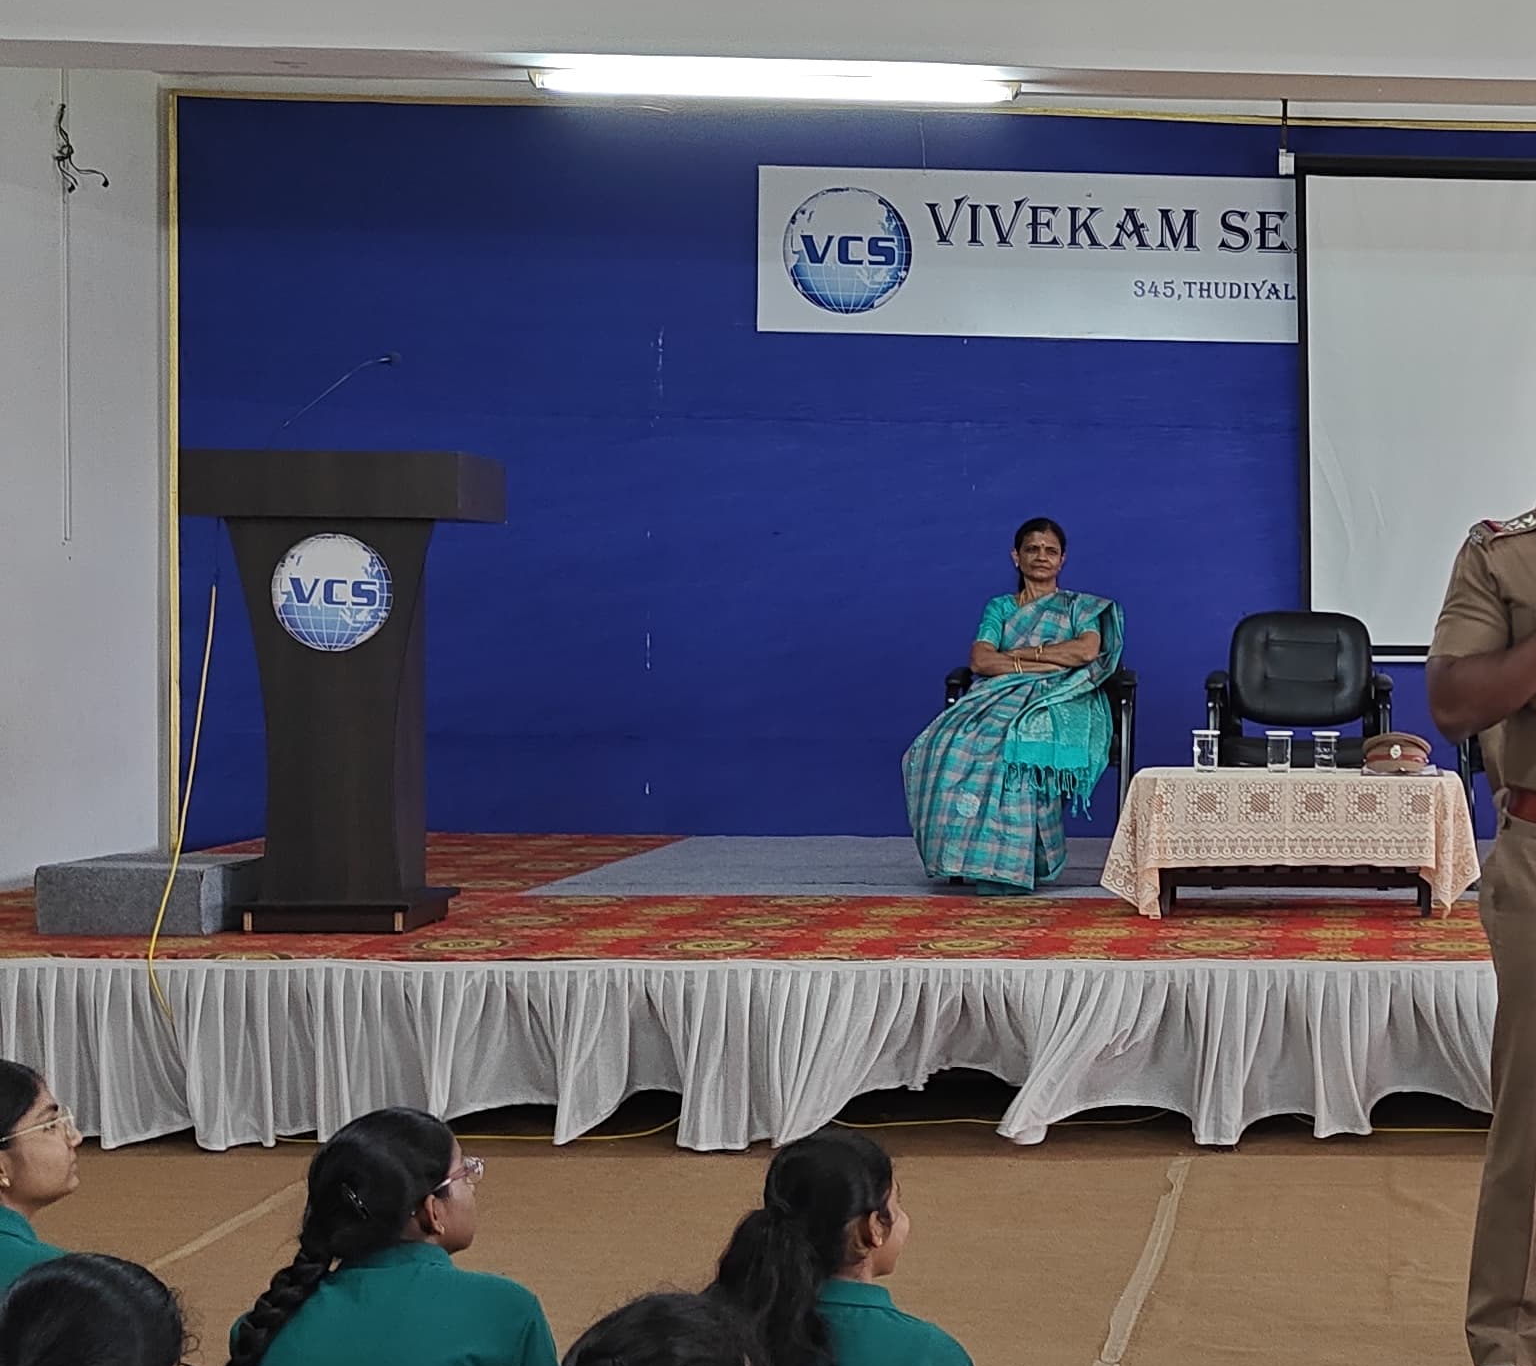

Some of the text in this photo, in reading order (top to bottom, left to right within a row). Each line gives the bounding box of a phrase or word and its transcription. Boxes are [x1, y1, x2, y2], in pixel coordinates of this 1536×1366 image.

[925, 195, 1201, 252] VIVEKAM
[1218, 209, 1298, 254] SE
[800, 235, 897, 267] VCS
[288, 577, 379, 607] VCS
